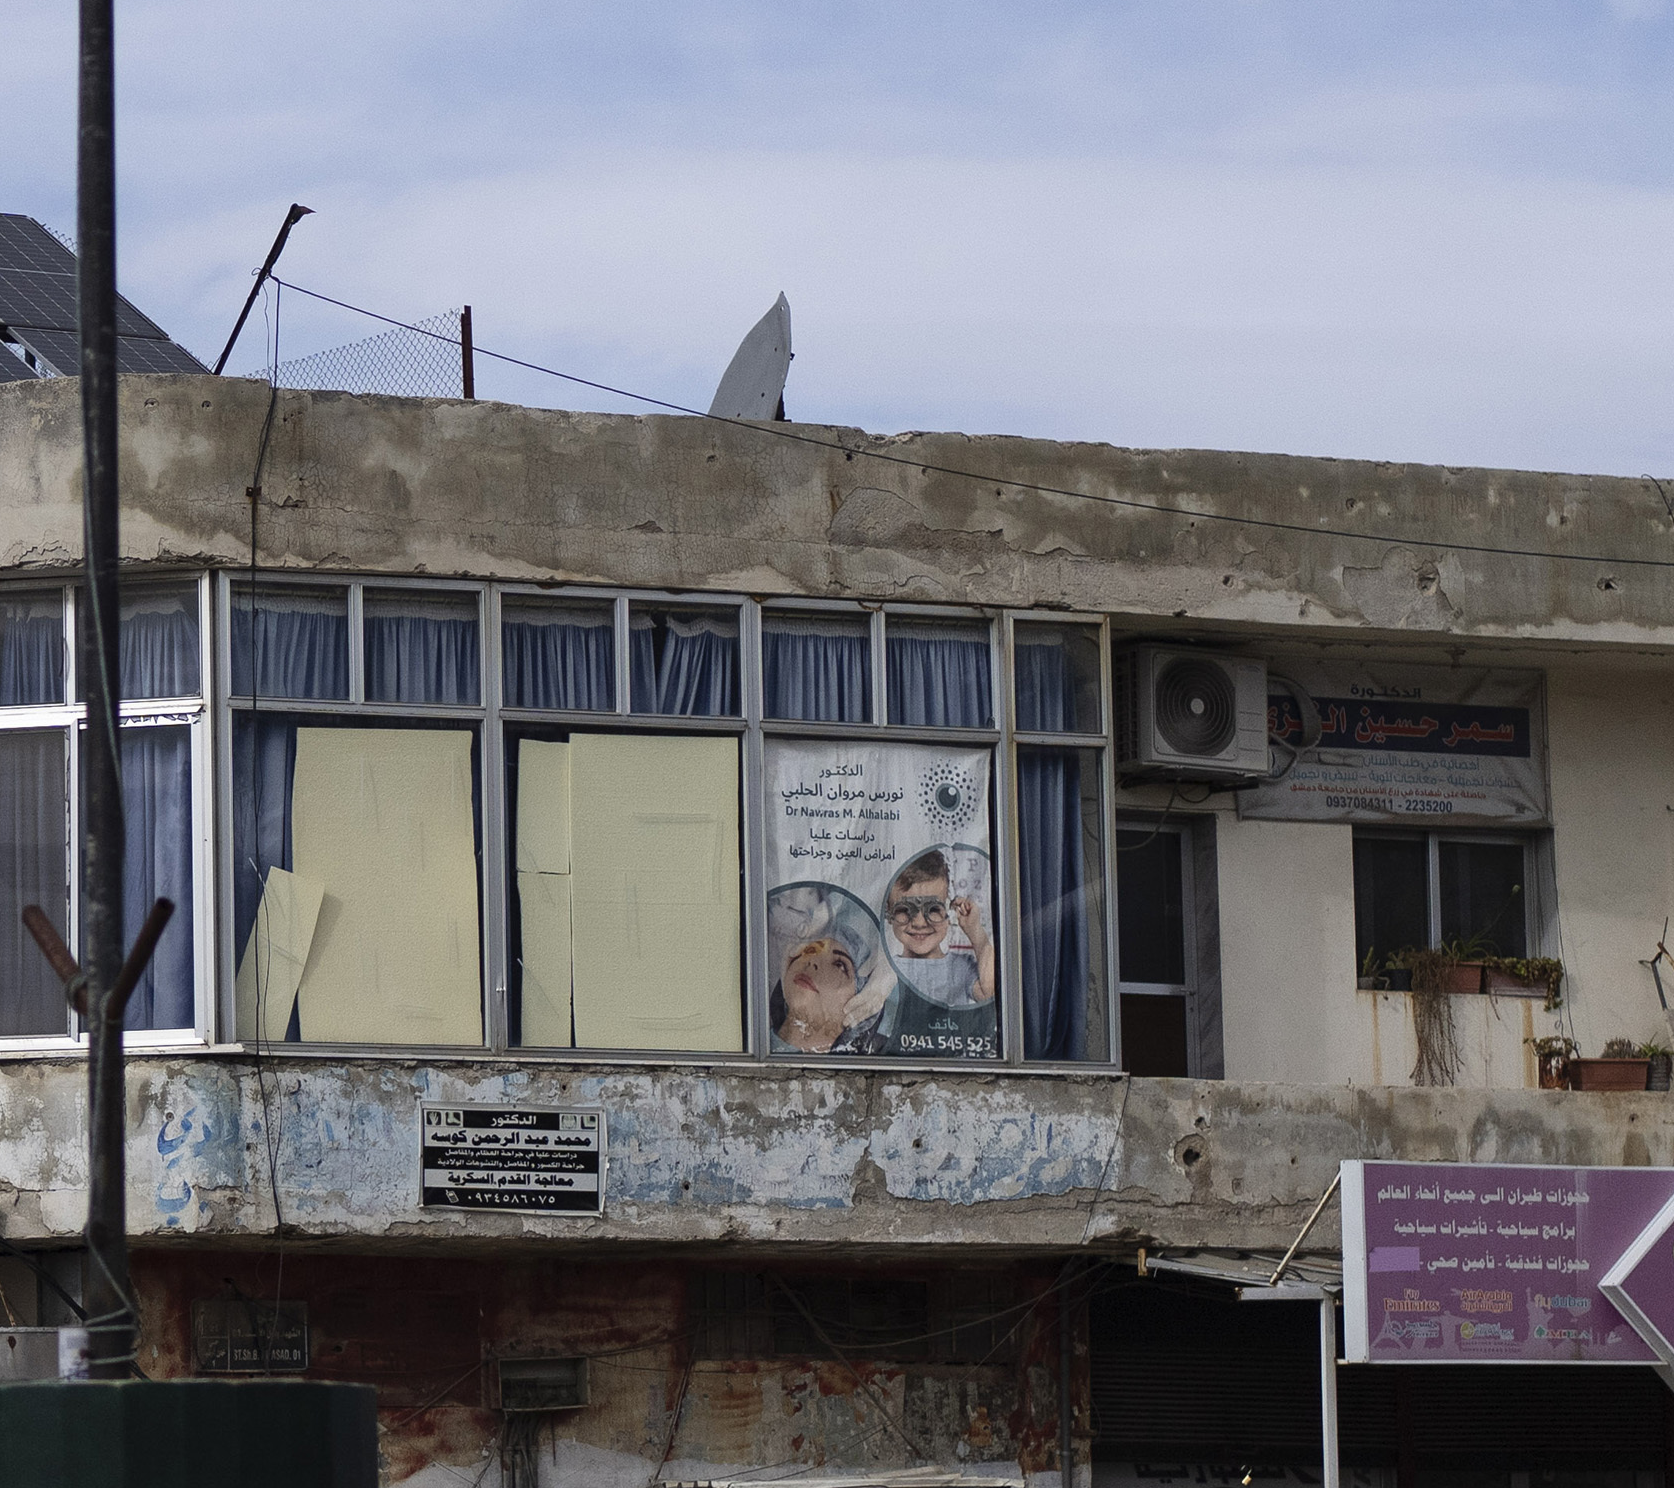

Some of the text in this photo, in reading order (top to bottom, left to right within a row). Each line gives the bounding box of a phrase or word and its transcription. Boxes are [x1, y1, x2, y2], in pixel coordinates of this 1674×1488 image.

[1350, 683, 1421, 699] الدكتورة
[1355, 705, 1439, 743] حسين
[1442, 721, 1514, 748] سمر
[819, 764, 863, 778] الدكتور
[781, 782, 904, 802] نورس مروان الحلبي
[1326, 795, 1453, 812] 0937084311 2235200
[786, 806, 900, 821] Dr Nawras M. Alhalabi
[810, 828, 875, 843] دراسات عليا
[789, 845, 895, 862] أمراض العين وجراحتها
[901, 1034, 935, 1049] 0941
[938, 1036, 963, 1050] 545
[490, 1114, 536, 1127] الدكتور
[431, 1130, 591, 1148] محمد عبد الرحمن كوسه
[448, 1172, 574, 1188] معالجة القدم السكرية
[1377, 1181, 1590, 1206] حجوزات طيران الى جميع أنحاء العالم
[1393, 1216, 1576, 1240] برامج سياحية تأشيرات سياحية
[1427, 1250, 1590, 1275] حجوزات فندقية تأمين صحي
[1384, 1298, 1441, 1312] Emirates
